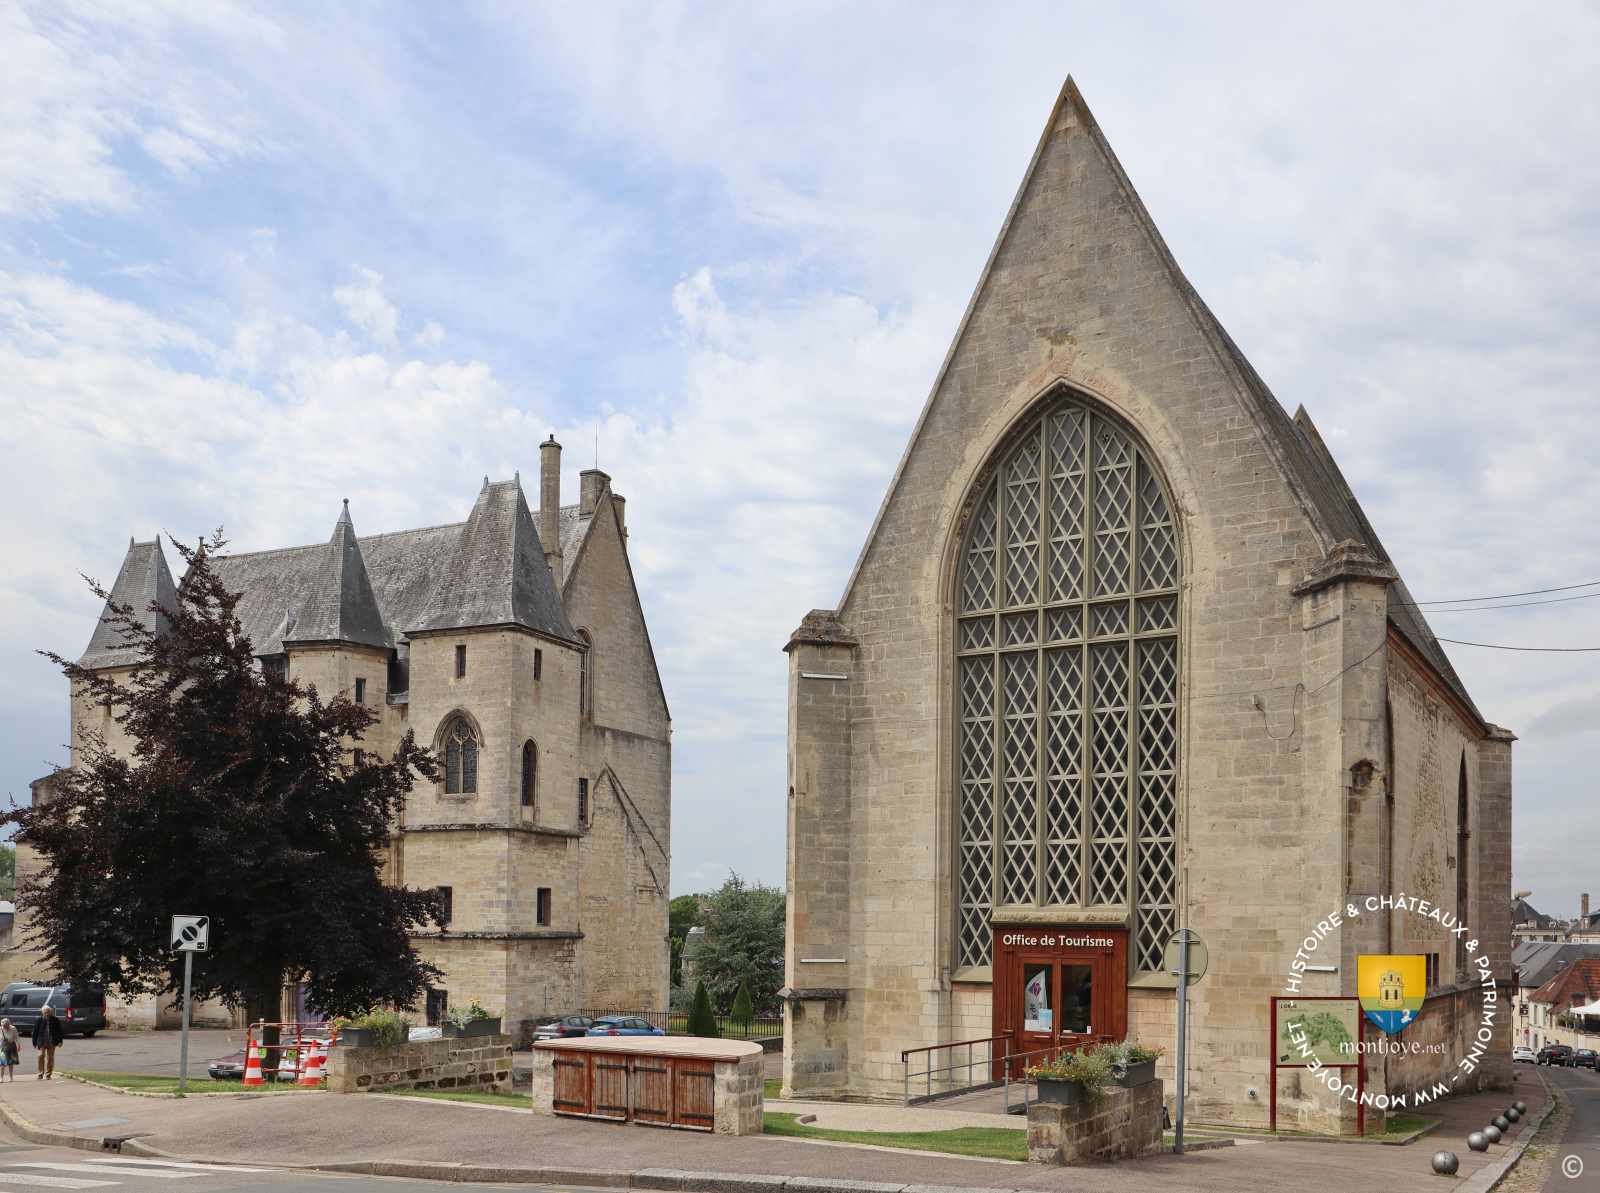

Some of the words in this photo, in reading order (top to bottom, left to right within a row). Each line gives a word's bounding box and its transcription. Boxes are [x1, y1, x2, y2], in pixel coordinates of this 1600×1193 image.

[1002, 934, 1037, 946] Office
[1040, 935, 1055, 946] de
[1059, 935, 1114, 947] Tourisme
